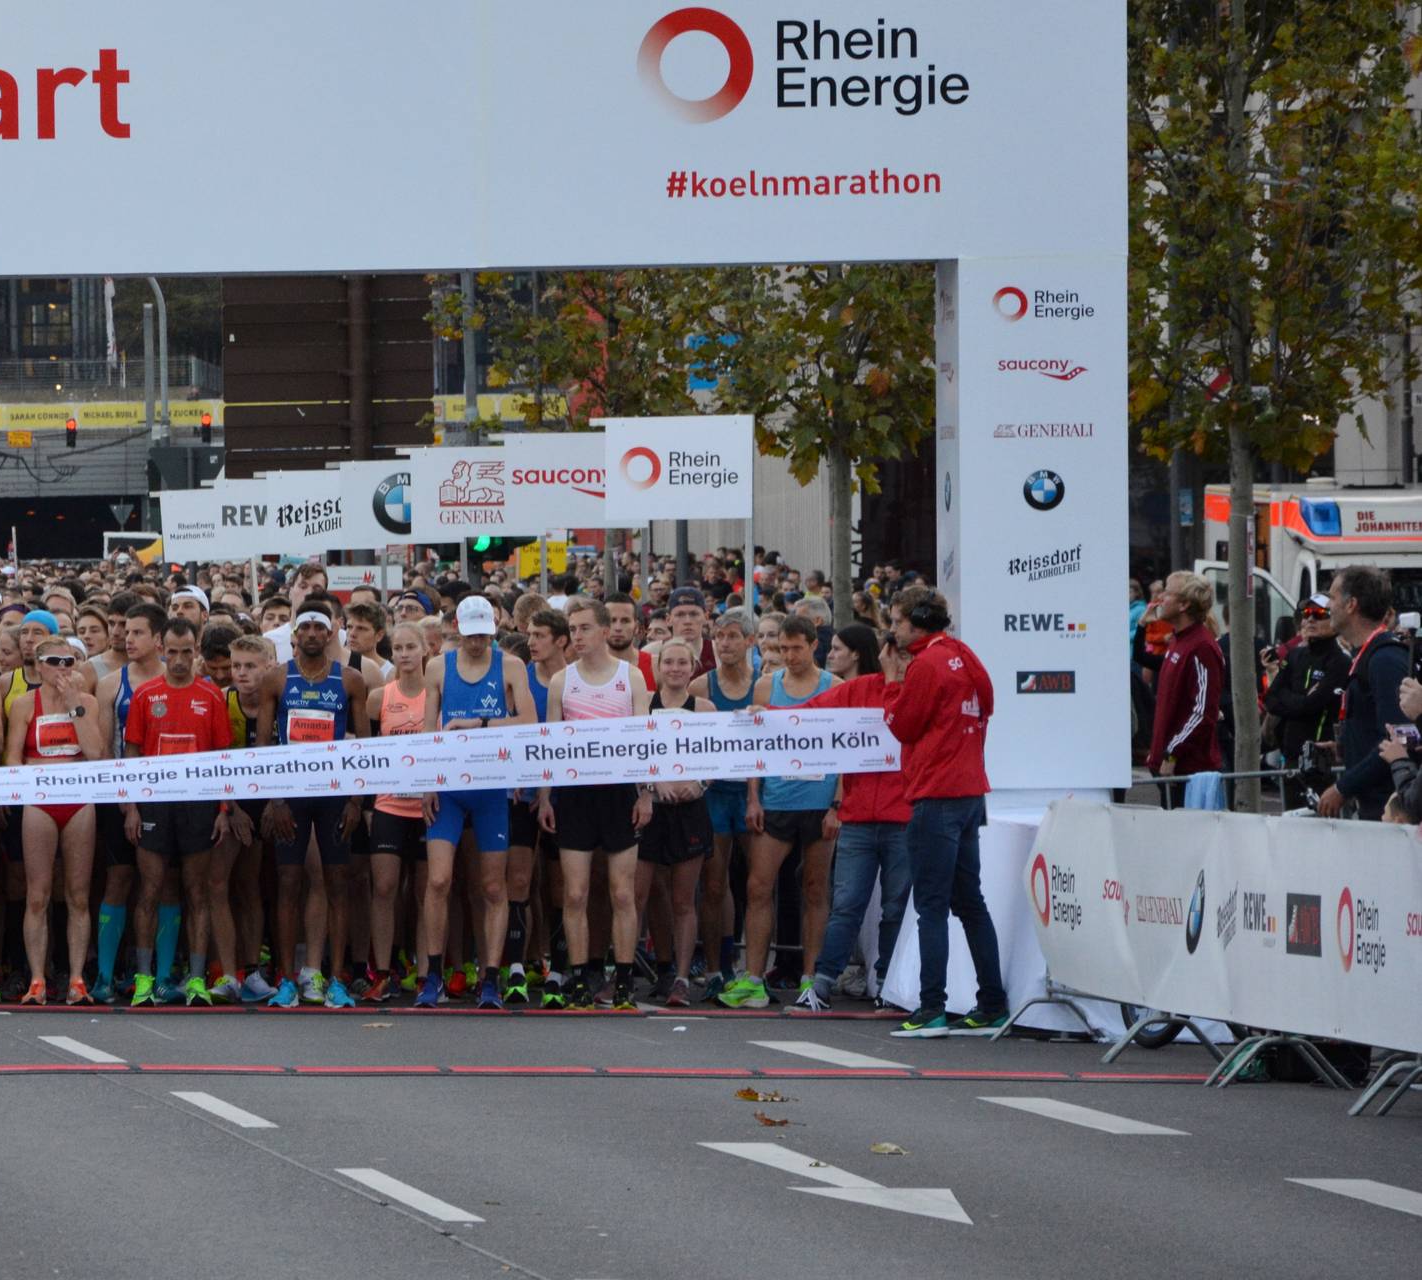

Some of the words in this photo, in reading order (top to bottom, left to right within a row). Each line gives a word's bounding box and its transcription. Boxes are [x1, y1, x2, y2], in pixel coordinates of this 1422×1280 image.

[777, 19, 918, 60] Rhein
[777, 64, 970, 115] Energie
[667, 168, 941, 197] #koelnmarathon
[1035, 290, 1079, 303] Rhein
[1035, 305, 1094, 321] Energie
[998, 359, 1069, 373] saucony
[1017, 423, 1093, 438] GENERALI
[669, 452, 720, 467] Rhein
[669, 469, 738, 488] Energie
[440, 510, 505, 524] GENERA
[1357, 511, 1375, 520] DIE
[1008, 544, 1081, 575] Reissdorf
[1028, 562, 1080, 582] ALKOHOLFREI
[1004, 613, 1065, 631] REWE
[526, 740, 667, 761] RheinEnergie
[675, 734, 823, 754] Halbmarathon
[831, 731, 880, 749] Köln
[36, 767, 177, 786] RheinEnergie
[185, 760, 333, 779] Halbmarathon
[342, 754, 390, 770] Köln
[1052, 864, 1074, 894] Rhein
[1052, 895, 1081, 931] Energie
[1244, 892, 1266, 931] REWE
[1356, 899, 1379, 931] Rhein
[1356, 934, 1386, 973] Energie
